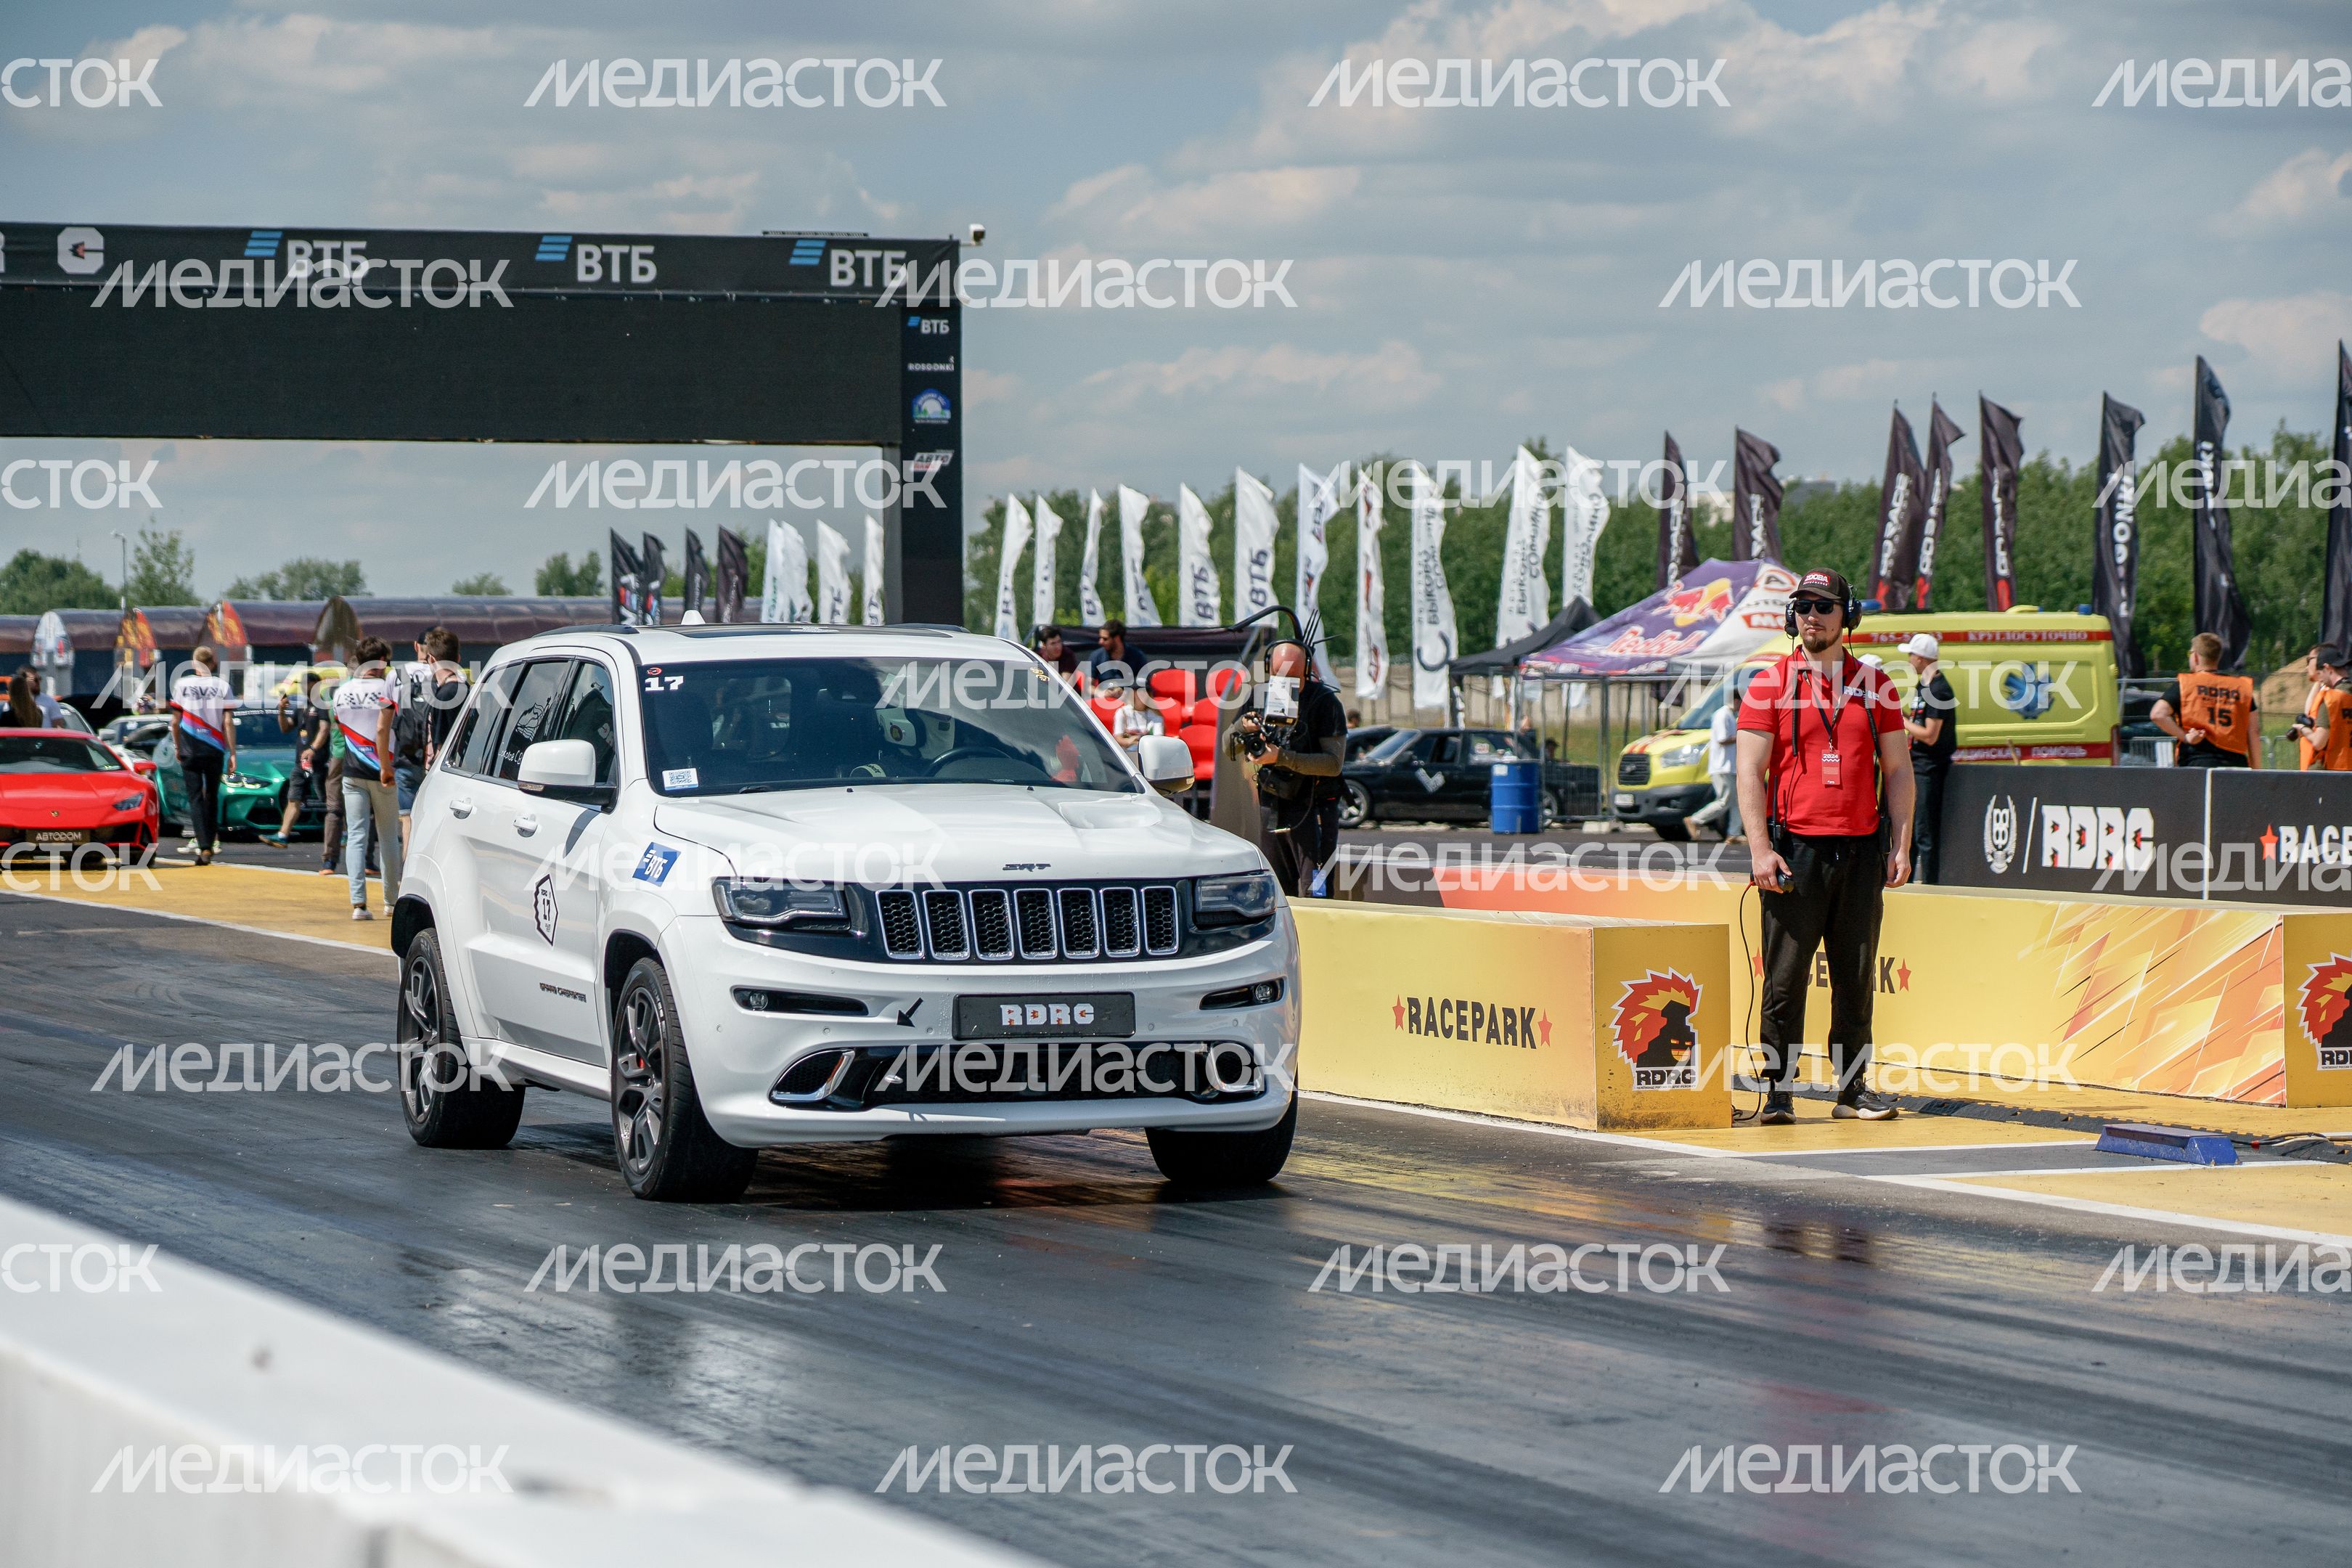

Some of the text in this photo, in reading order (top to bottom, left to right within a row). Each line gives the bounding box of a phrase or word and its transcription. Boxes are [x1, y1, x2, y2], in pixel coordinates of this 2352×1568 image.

[287, 240, 369, 279] ВТБ
[576, 244, 657, 283] ВТБ
[830, 250, 907, 287] ВТБ
[920, 319, 950, 334] ВТБ
[1191, 563, 1214, 619] ВТБ
[1249, 547, 1268, 607] ВТБ
[645, 676, 684, 690] 17
[2207, 706, 2232, 727] 15
[2042, 805, 2154, 871] RDRC
[645, 855, 668, 878] ВТБ
[1000, 1003, 1095, 1026] RDRC
[1407, 997, 1537, 1050] RACEPARK
[2321, 1050, 2352, 1065] RD
[1636, 1069, 1696, 1085] RDRC
